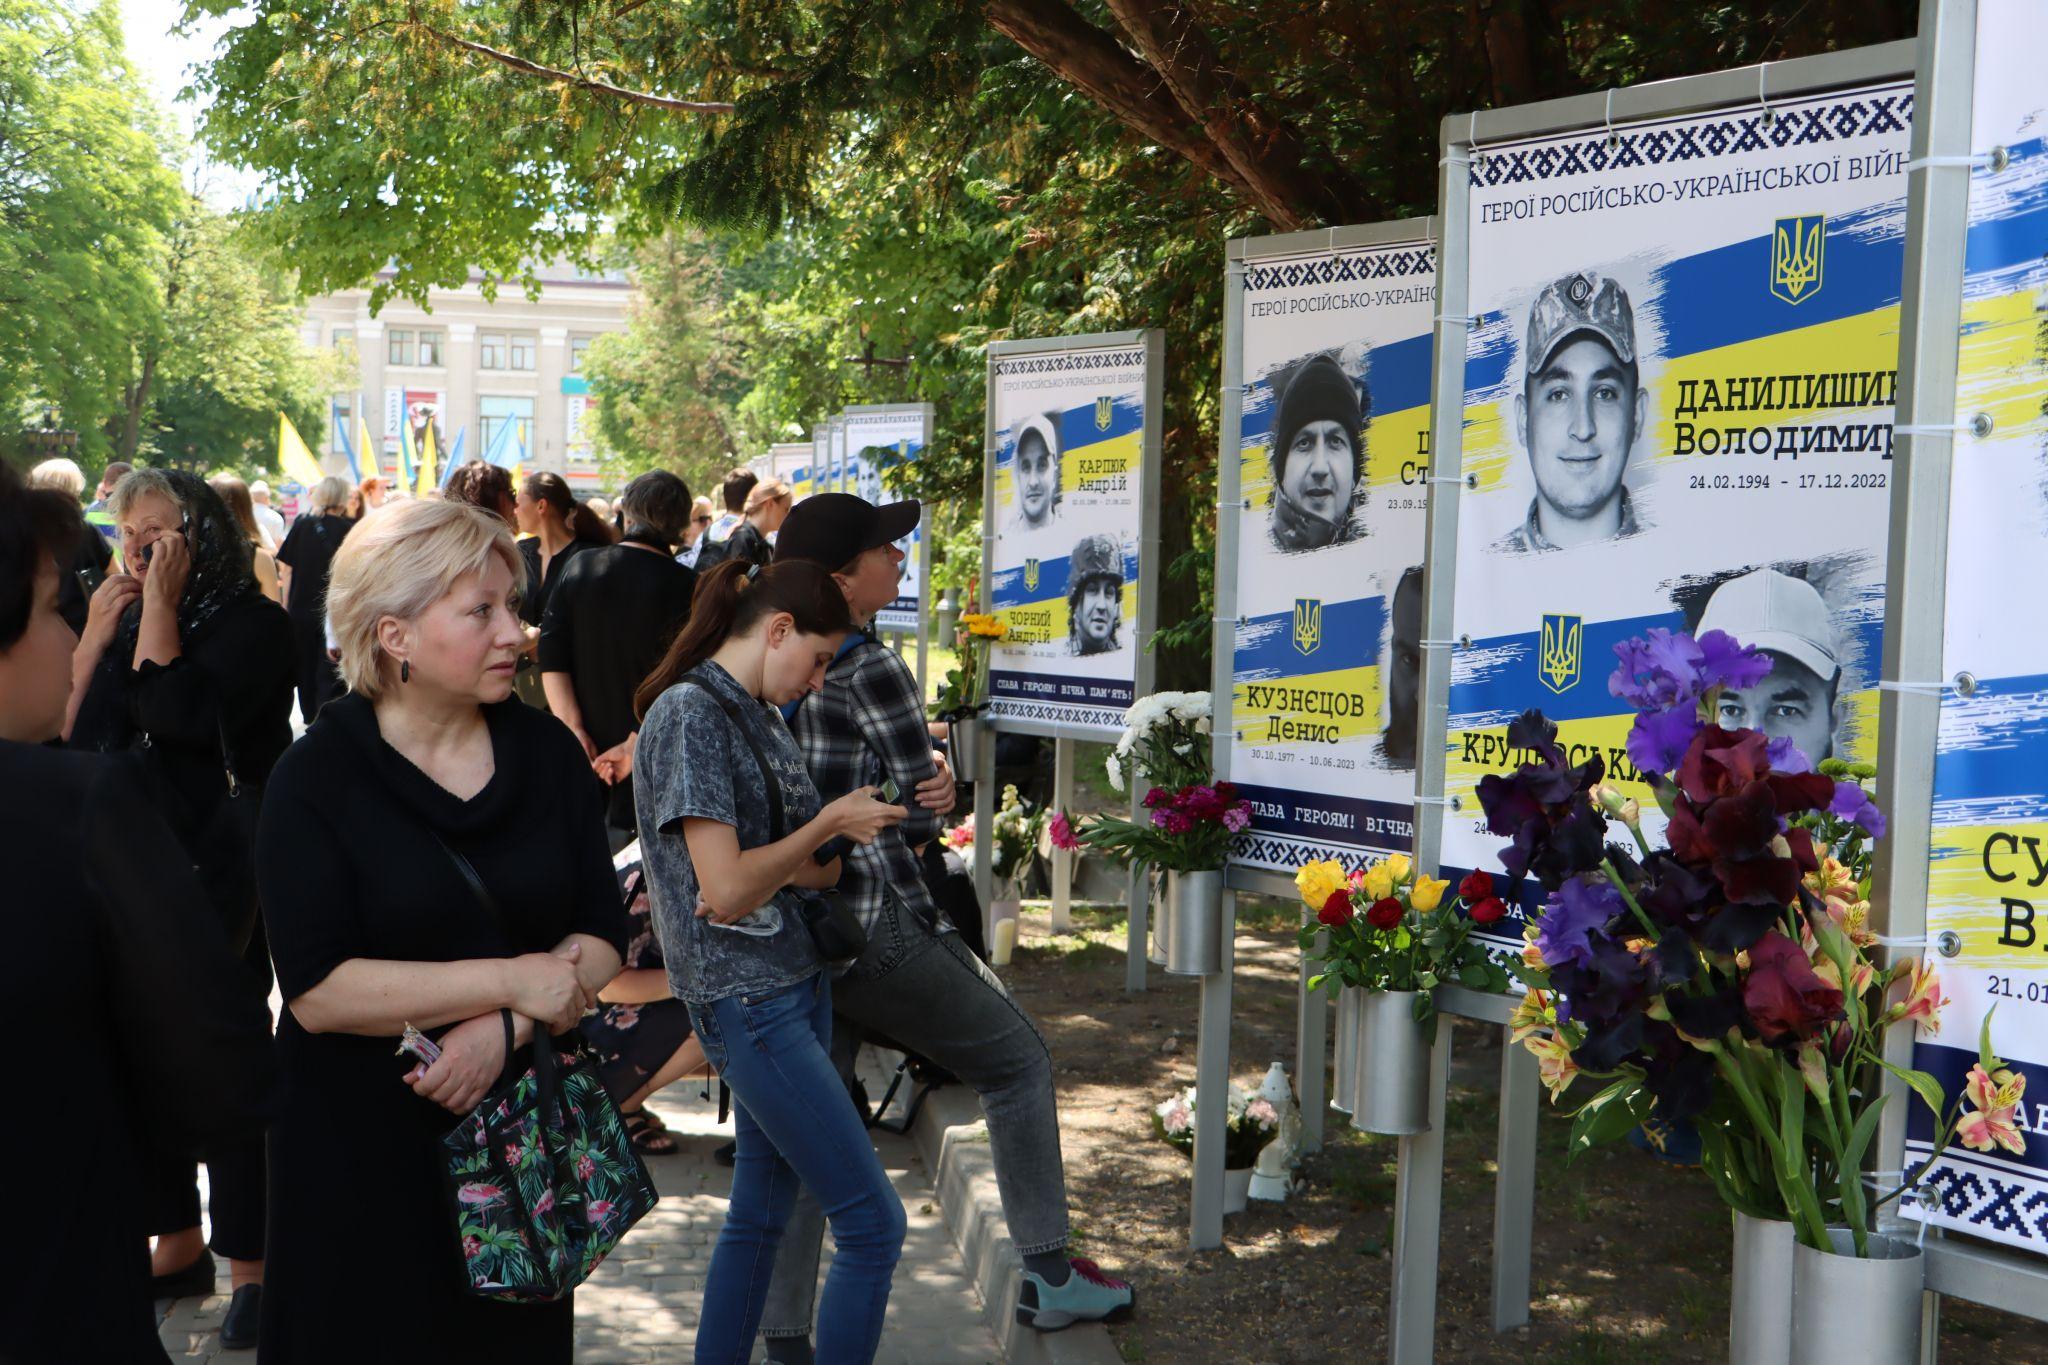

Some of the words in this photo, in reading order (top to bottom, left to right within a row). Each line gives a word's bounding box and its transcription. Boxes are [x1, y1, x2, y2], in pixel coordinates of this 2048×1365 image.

[1481, 194, 1535, 223] ГЕРОЇ
[1540, 160, 1844, 216] РОСІЙСЬКО-УКРАЇНСЬКОЇ
[1251, 298, 1287, 316] ГЕРОЇ
[1078, 458, 1127, 474] КАРПЮК
[1078, 474, 1127, 494] Андрій
[1689, 475, 1770, 489] 24.02.1994
[1799, 474, 1886, 489] 17.12.2022
[1009, 609, 1052, 627] ЧОРНИЙ
[1008, 628, 1051, 645] Андрій
[996, 679, 1019, 690] СЛАВА
[1023, 681, 1056, 694] ГЕРОЯМ!
[1061, 685, 1086, 696] ВІЧНА
[1246, 685, 1364, 719] КУЗНЄЦОВ
[1267, 715, 1339, 744] Денис
[1251, 749, 1295, 763] 30.10.1977
[1310, 756, 1355, 769] 10.06.2023
[1250, 801, 1285, 819] ЛАВА
[1294, 807, 1355, 829] ГЕРОЯМ!
[1366, 817, 1414, 837] ВІЧНА
